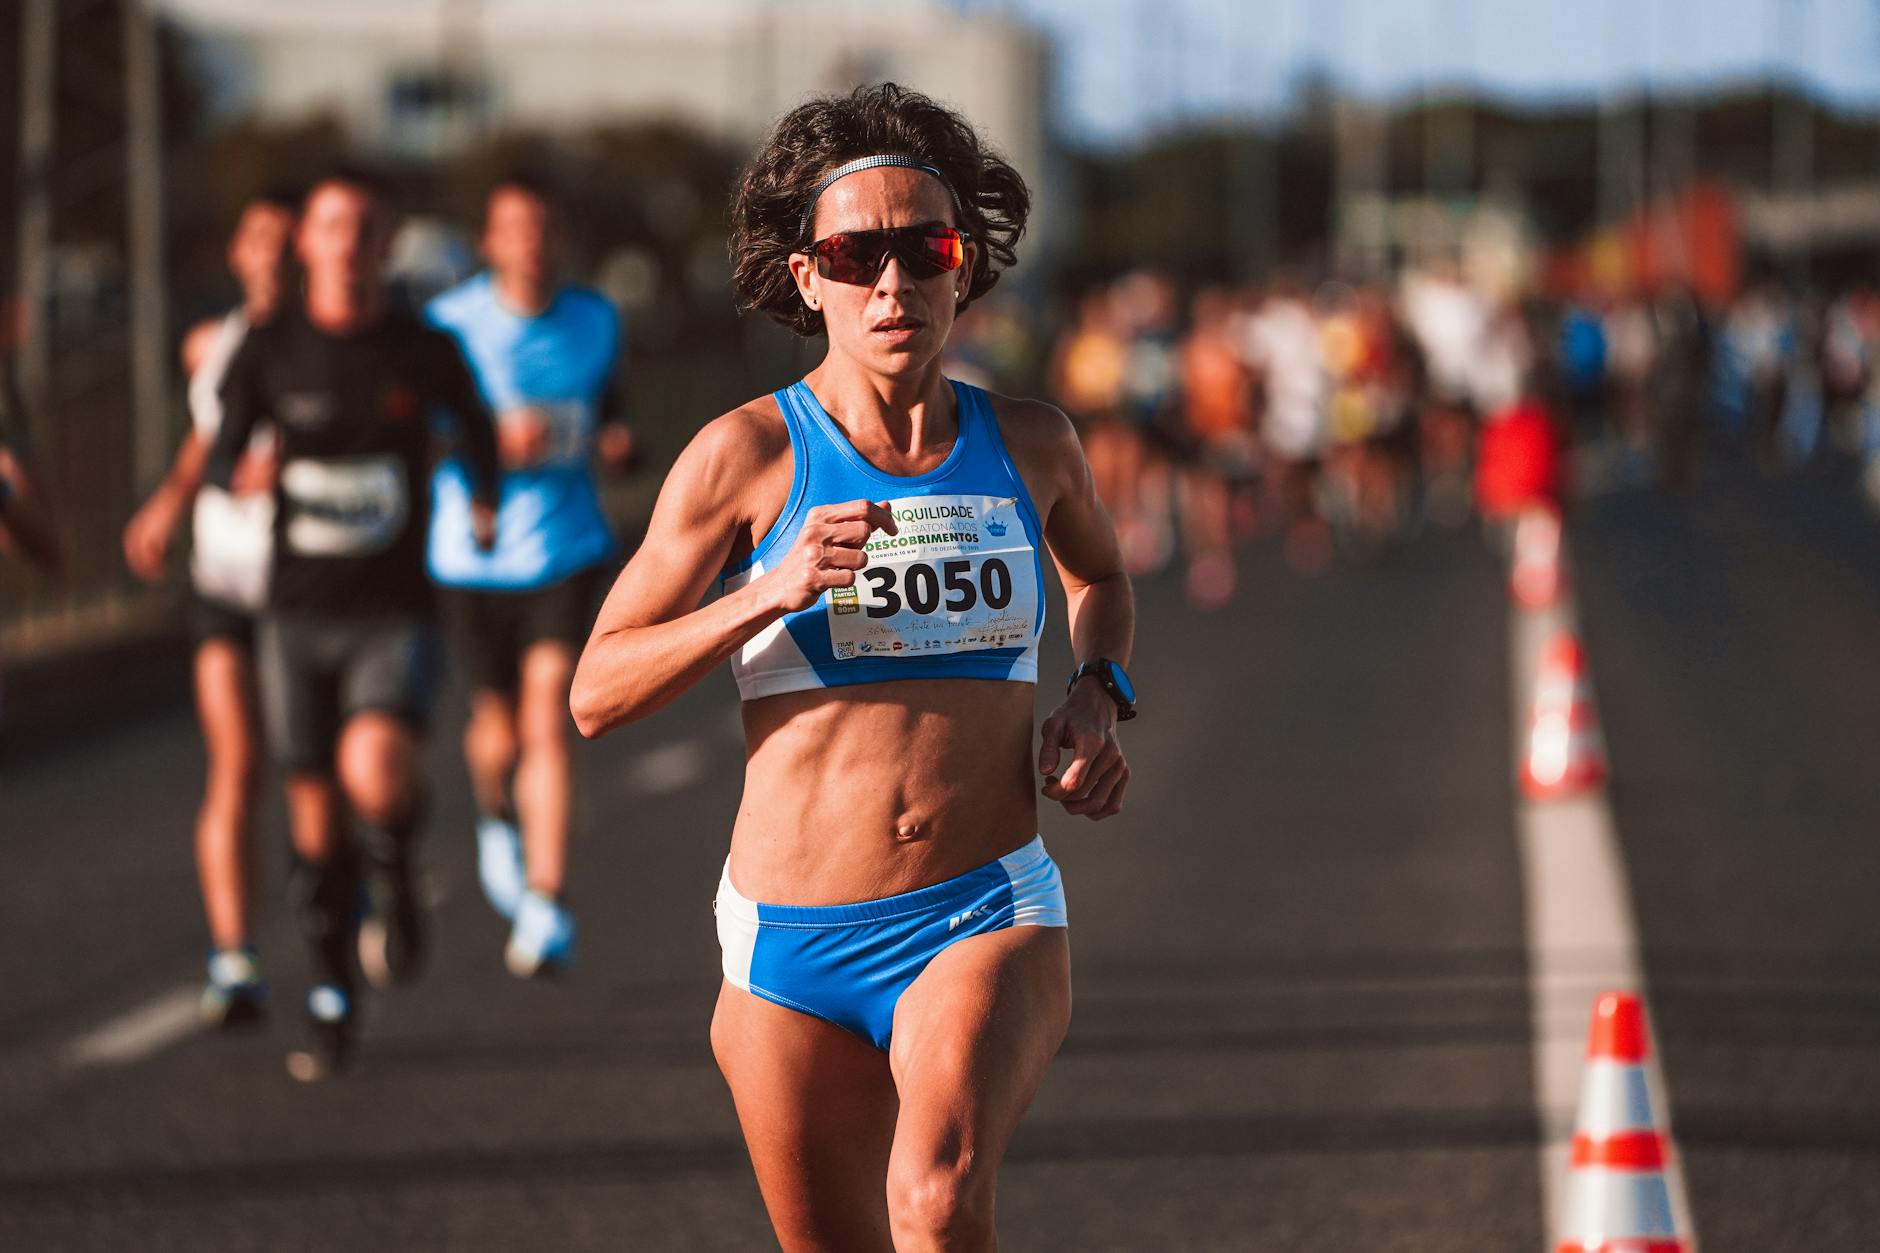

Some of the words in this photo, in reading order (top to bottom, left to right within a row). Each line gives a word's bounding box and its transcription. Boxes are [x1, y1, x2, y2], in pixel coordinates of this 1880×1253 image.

[890, 506, 975, 523] NQUILIDADE
[957, 522, 978, 533] DOS
[865, 532, 980, 552] DESCOBRIMENTOS
[862, 558, 1012, 619] 3050
